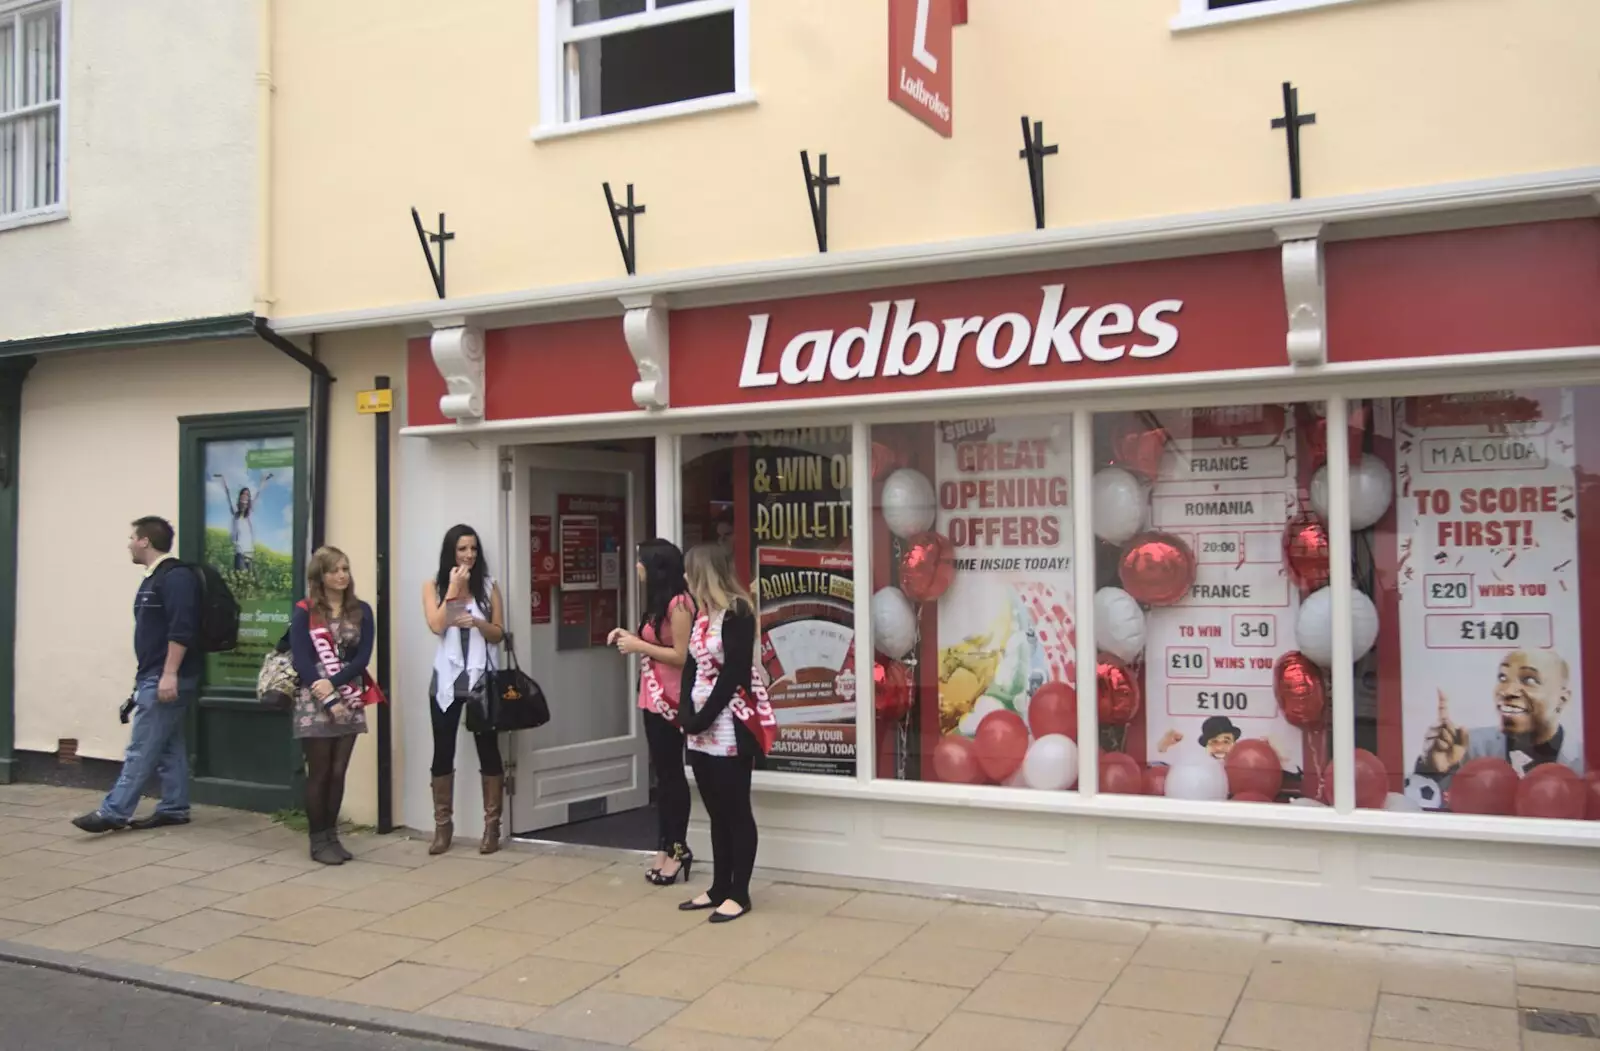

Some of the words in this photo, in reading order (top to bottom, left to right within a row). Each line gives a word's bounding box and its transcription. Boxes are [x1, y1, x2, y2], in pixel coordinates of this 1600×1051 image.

[900, 66, 950, 122] Ladbrokes
[738, 284, 1184, 389] Ladbrokes
[956, 439, 1049, 473] GREAT
[1190, 456, 1250, 473] FRANCE
[1432, 442, 1540, 465] MALOUDA
[753, 457, 772, 493] &
[776, 455, 822, 492] WIN
[939, 476, 1069, 511] OPENING
[1413, 488, 1450, 516] TO
[1460, 486, 1558, 514] SCORE
[1184, 500, 1255, 517] ROMANIA
[754, 500, 853, 546] ROULETT
[948, 515, 1061, 548] OFFERS
[1437, 519, 1533, 547] FIRST!
[1203, 541, 1236, 553] 20:00
[980, 557, 1022, 571] INSIDE
[1023, 556, 1071, 570] TODAY!
[760, 570, 829, 600] ROULETTE
[1192, 584, 1251, 599] FRANCE
[1431, 582, 1467, 599] £20
[1478, 584, 1515, 597] WINS
[1519, 583, 1547, 597] YOU
[1179, 625, 1195, 637] TO
[1197, 625, 1222, 638] WIN
[1239, 621, 1269, 638] 3-0
[1460, 620, 1520, 641] £140
[1171, 653, 1203, 669] £10
[1213, 656, 1245, 669] WINS
[1249, 657, 1273, 669] YOU
[1196, 691, 1248, 710] £100
[781, 728, 802, 740] PICK
[803, 729, 817, 740] UP
[818, 730, 844, 742] YOUR
